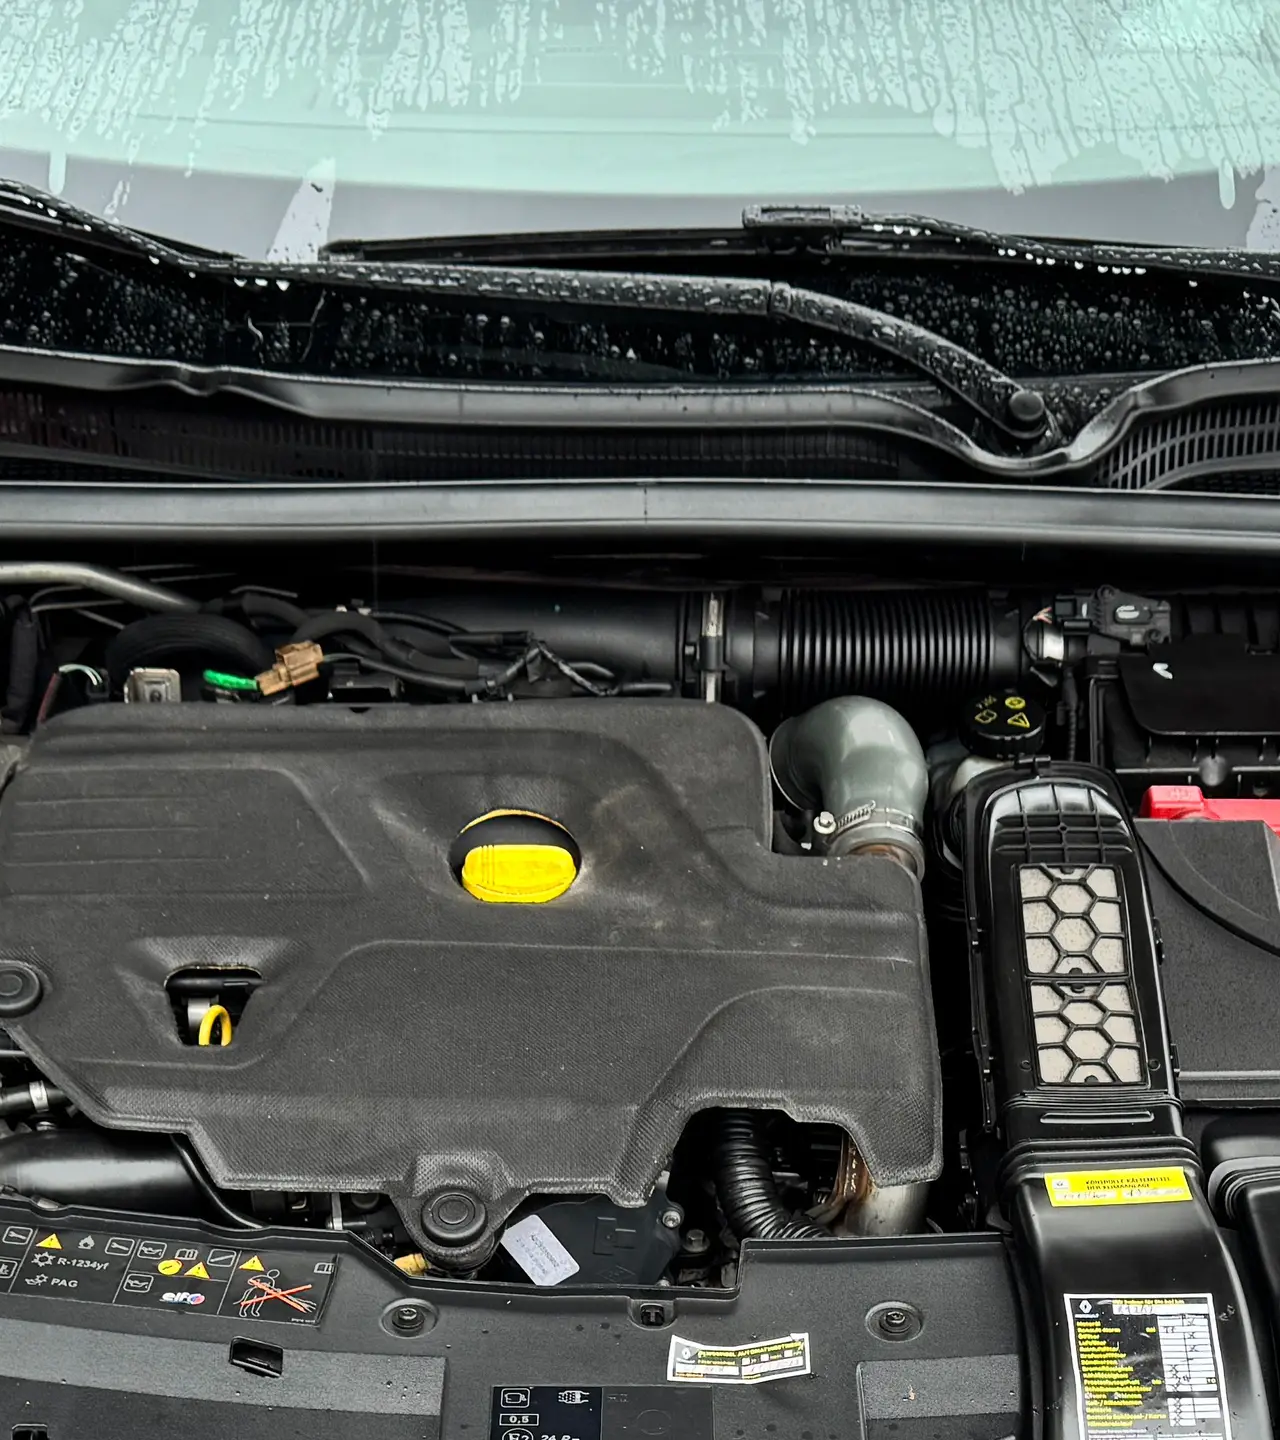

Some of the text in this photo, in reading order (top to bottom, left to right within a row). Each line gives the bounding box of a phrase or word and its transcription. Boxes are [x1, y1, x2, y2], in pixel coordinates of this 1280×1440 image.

[57, 1257, 109, 1270] R-1234yf
[51, 1278, 78, 1288] PAG
[162, 1292, 192, 1303] elf
[509, 1416, 530, 1424] 0,5
